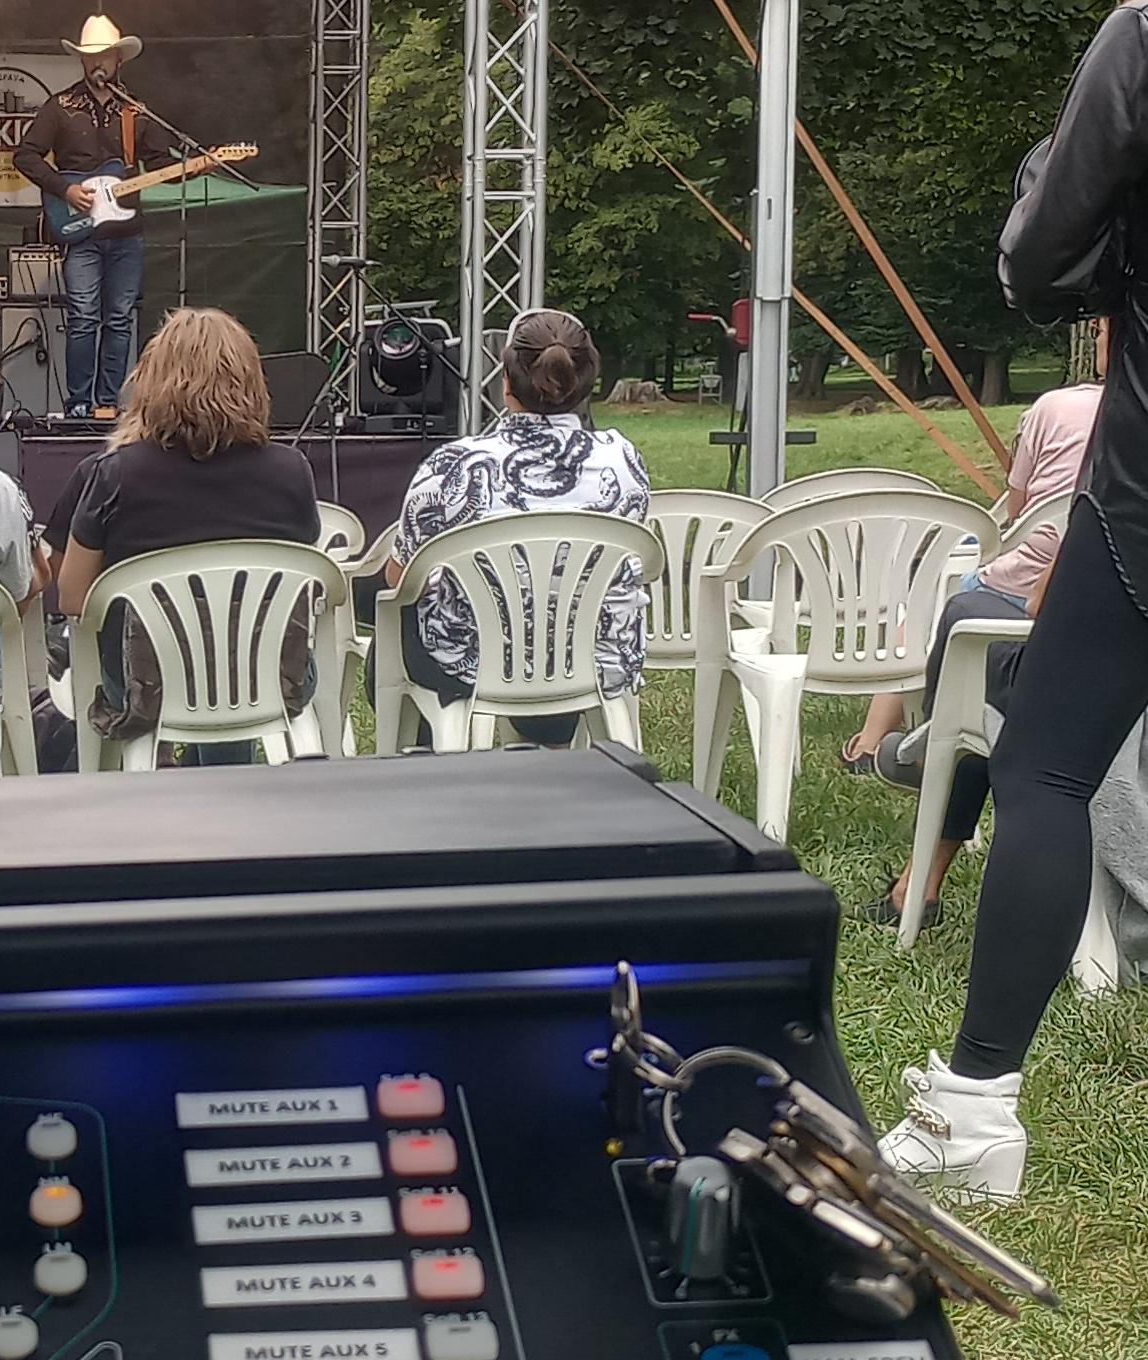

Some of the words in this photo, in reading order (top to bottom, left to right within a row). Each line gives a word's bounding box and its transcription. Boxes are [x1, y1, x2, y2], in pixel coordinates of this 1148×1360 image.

[209, 1101, 270, 1116] MUTE
[275, 1099, 321, 1113] AUX
[326, 1099, 339, 1111] 1
[218, 1157, 281, 1173] MUTE
[286, 1156, 333, 1169] AUX
[339, 1154, 352, 1168] 2
[226, 1213, 292, 1230] MUTE
[297, 1211, 345, 1225] AUX
[350, 1210, 364, 1224] 3
[235, 1276, 302, 1293] MUTE
[307, 1275, 357, 1290] AUX
[362, 1273, 377, 1289] 4
[319, 1342, 370, 1358] AUX
[375, 1341, 390, 1357] 5
